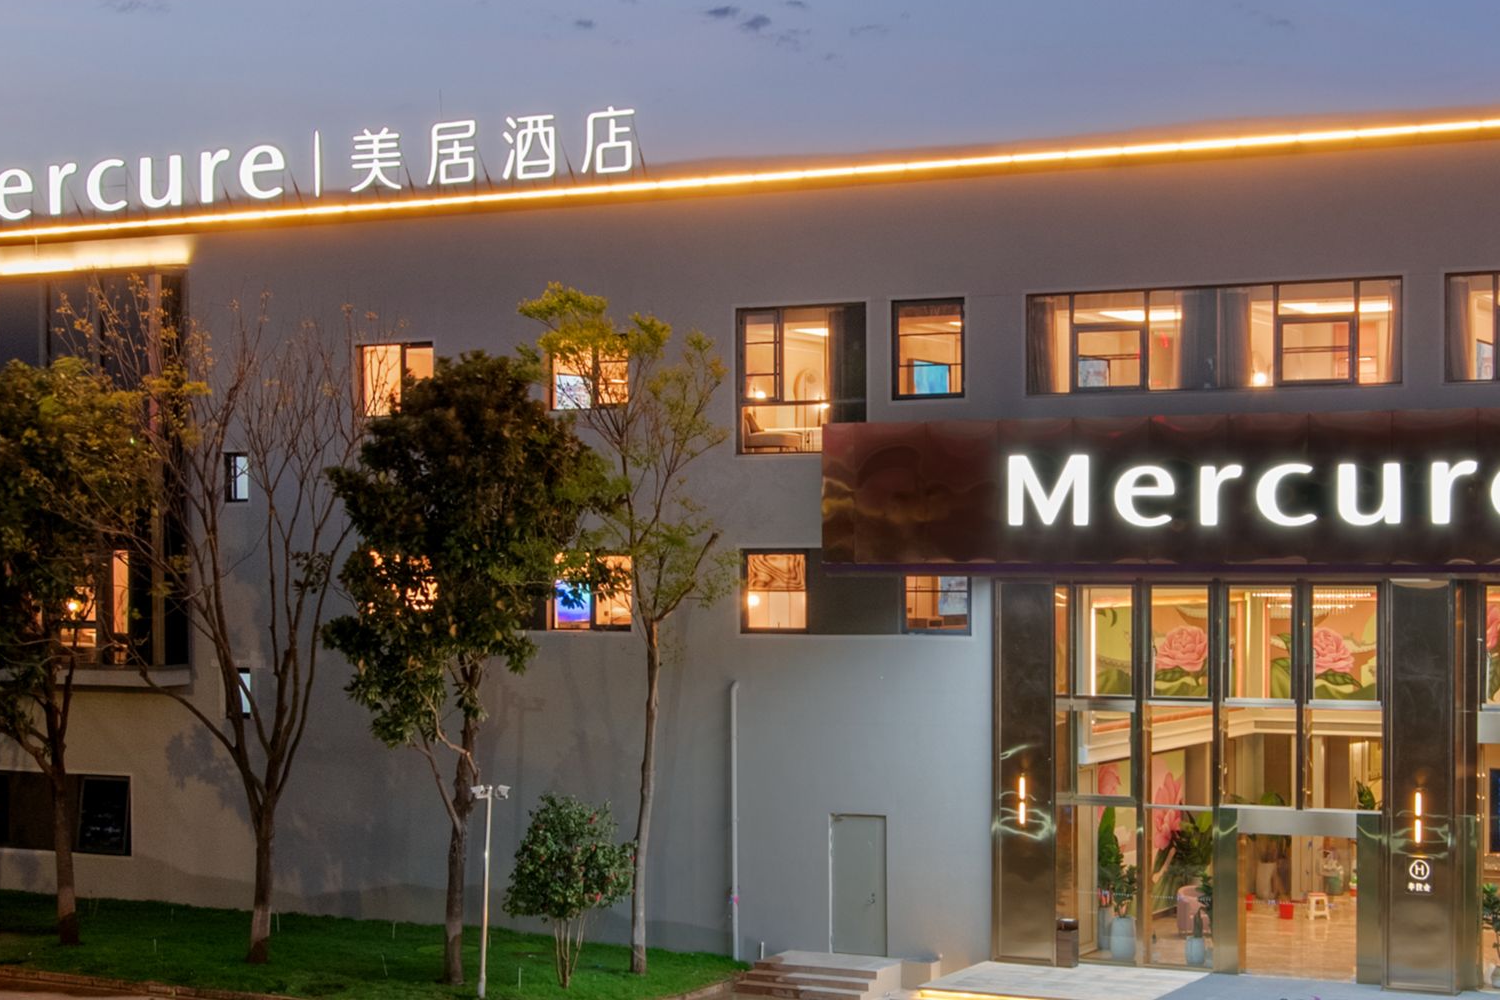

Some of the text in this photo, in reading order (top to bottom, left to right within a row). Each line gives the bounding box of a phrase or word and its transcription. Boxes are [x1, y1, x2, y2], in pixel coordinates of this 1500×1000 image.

[350, 106, 636, 193] 美居酒店
[1007, 453, 1500, 527] Mercur
